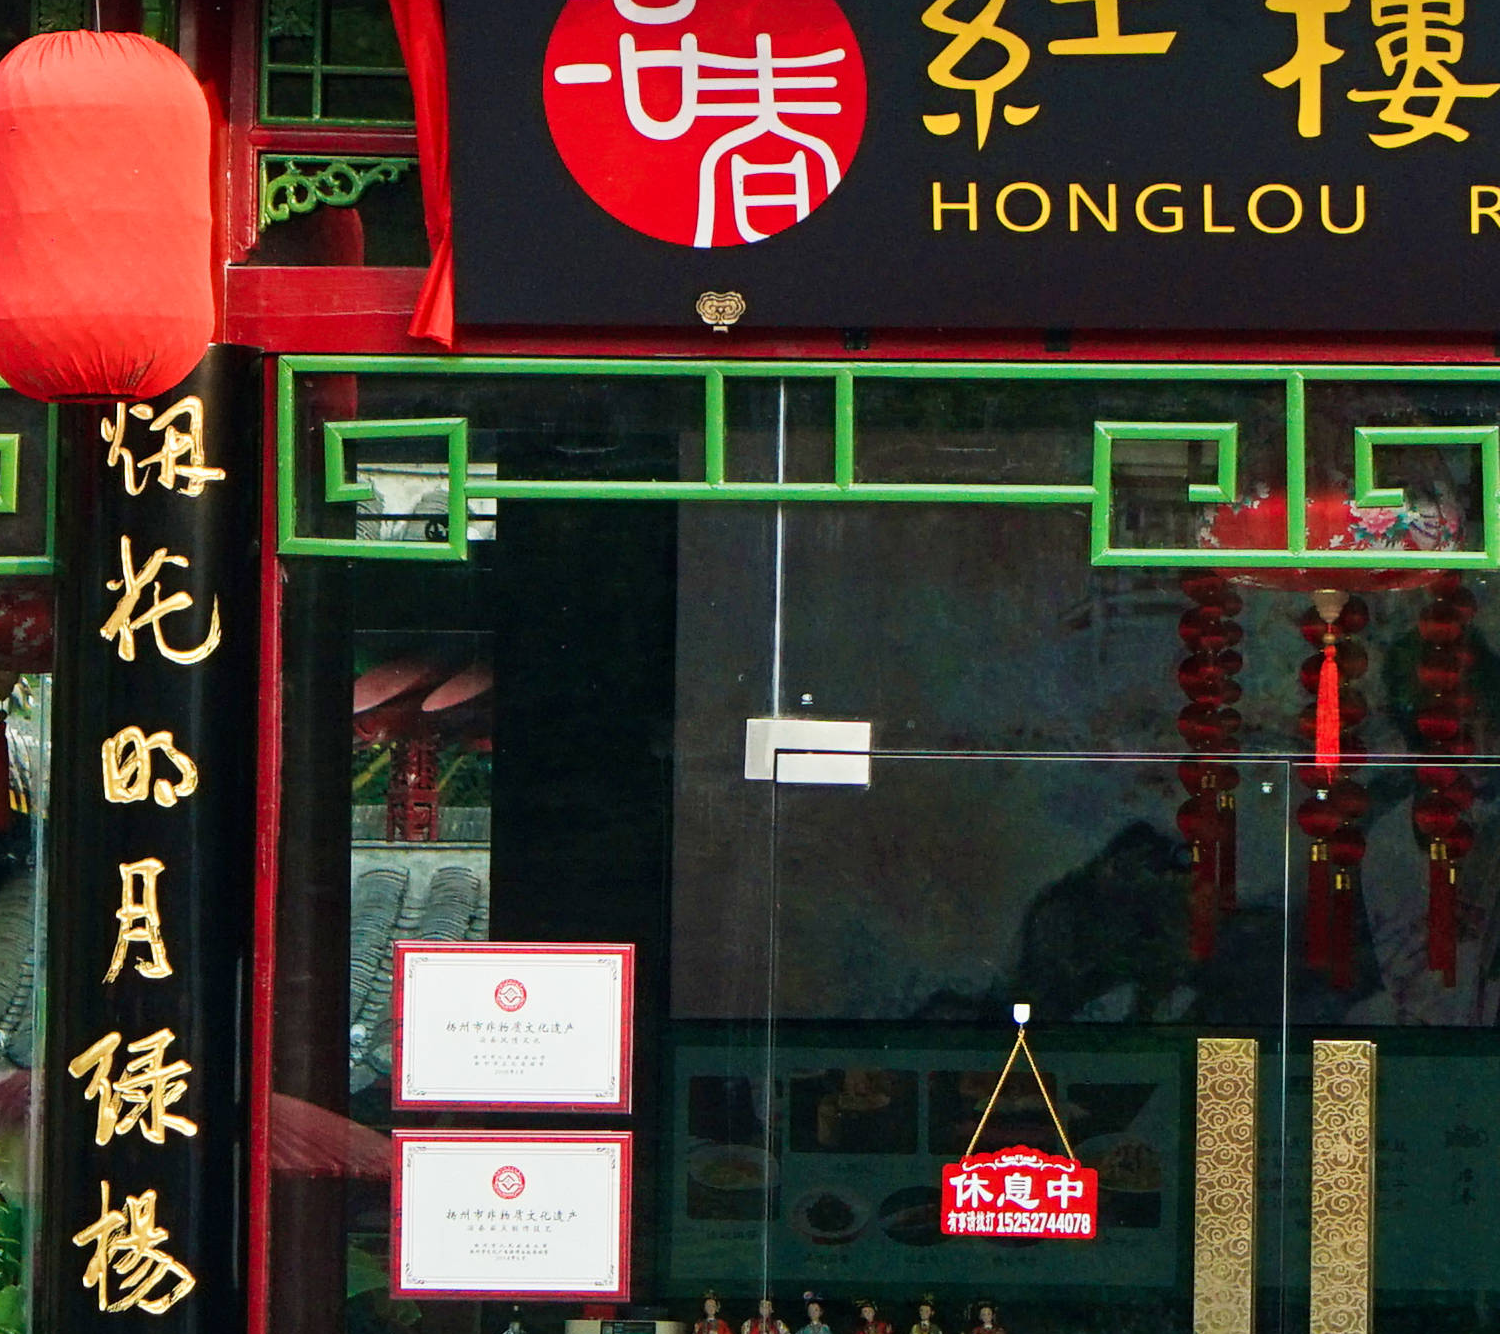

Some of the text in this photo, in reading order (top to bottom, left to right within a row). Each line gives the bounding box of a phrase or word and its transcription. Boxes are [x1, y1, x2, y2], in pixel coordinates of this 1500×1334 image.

[932, 181, 1366, 235] HONGLOU
[949, 1171, 1083, 1211] 休息中
[996, 1211, 1091, 1235] 15252744078
